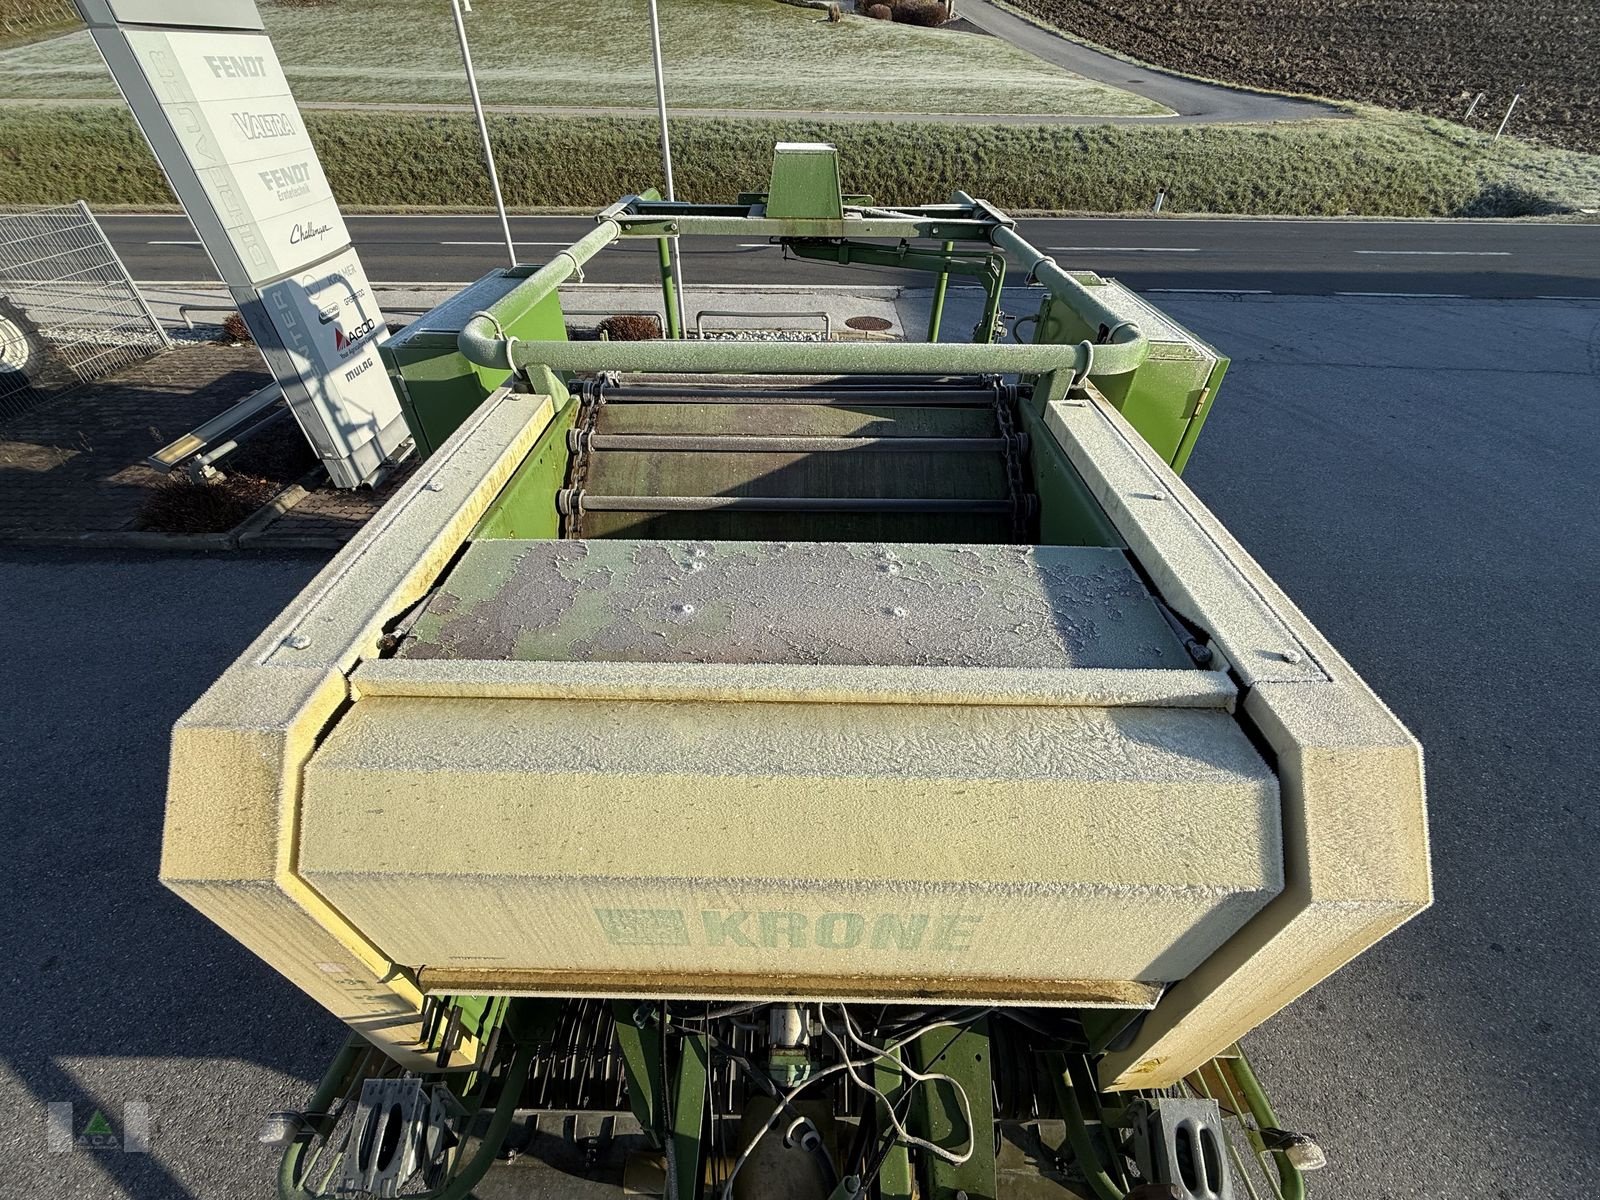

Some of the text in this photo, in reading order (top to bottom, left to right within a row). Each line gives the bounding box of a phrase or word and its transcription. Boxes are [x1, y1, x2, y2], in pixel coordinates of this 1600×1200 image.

[203, 56, 266, 78] FENDT
[258, 162, 310, 191] FENDT
[290, 221, 334, 244] Challenger
[348, 318, 375, 343] AGCO
[345, 357, 374, 382] MULAG
[700, 909, 984, 952] KRONE
